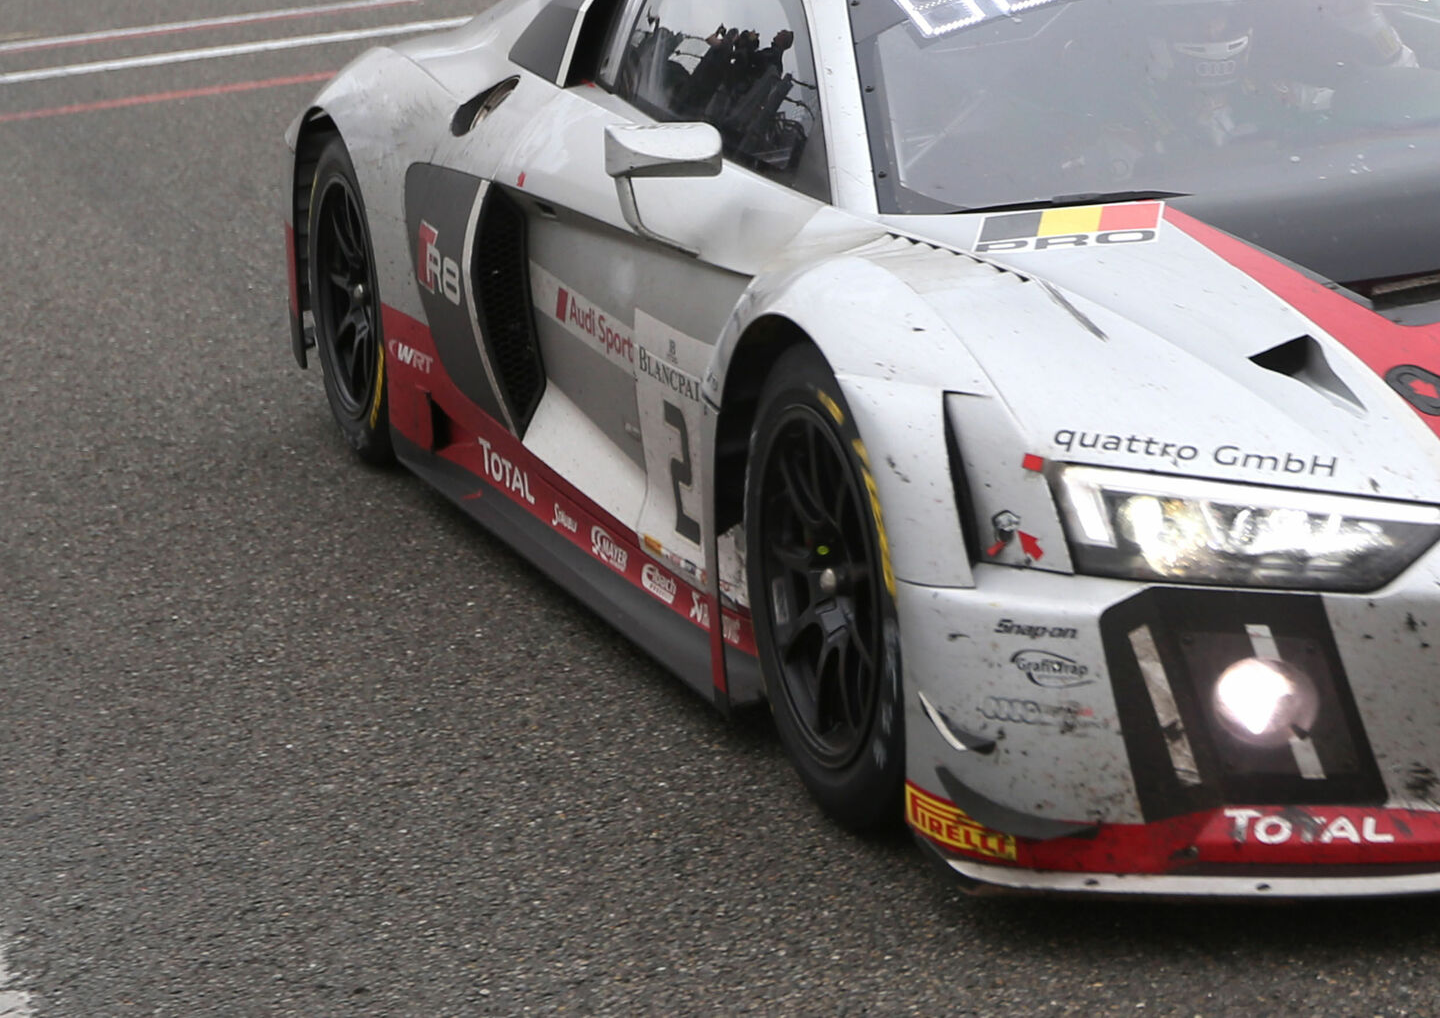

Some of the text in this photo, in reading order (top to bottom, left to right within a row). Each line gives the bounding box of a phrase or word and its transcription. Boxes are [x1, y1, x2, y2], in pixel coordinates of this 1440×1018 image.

[976, 229, 1155, 253] PRO
[426, 243, 460, 306] R8
[397, 342, 433, 374] WRT
[569, 296, 634, 364] Audi Sport
[478, 436, 535, 505] TOTAL
[663, 399, 701, 546] 2
[1053, 428, 1339, 478] quattro GmbH
[994, 619, 1078, 640] Snap-on
[911, 791, 1006, 856] PIRELLI
